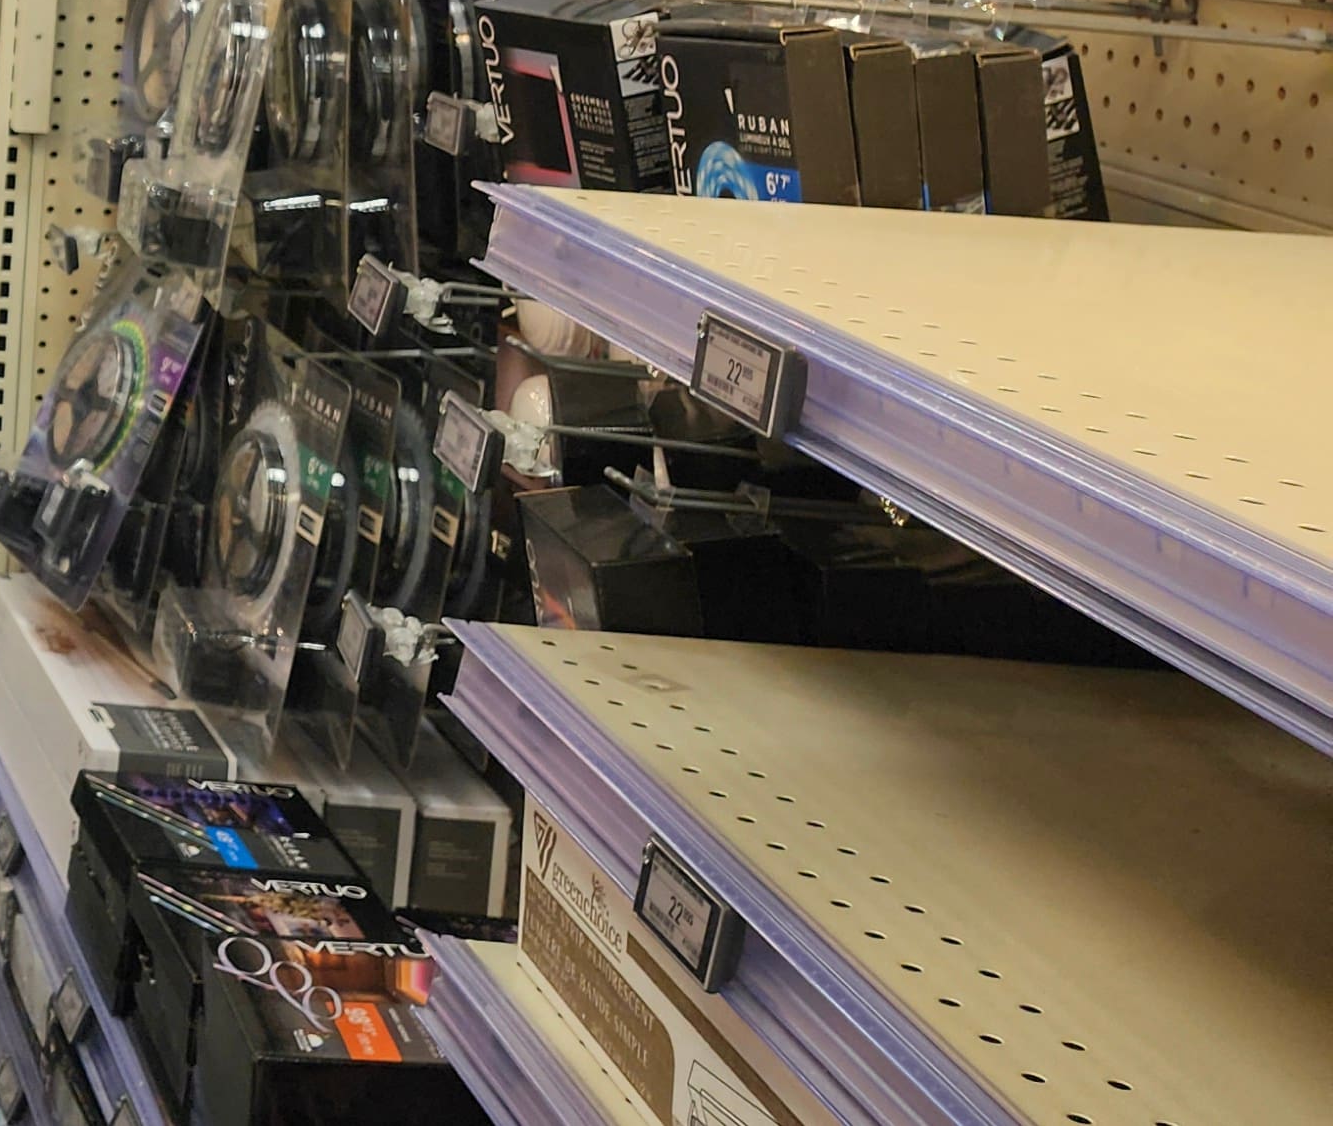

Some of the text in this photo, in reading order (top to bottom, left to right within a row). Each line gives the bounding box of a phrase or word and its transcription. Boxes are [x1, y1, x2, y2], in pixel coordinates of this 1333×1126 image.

[478, 15, 515, 146] VERTUO
[660, 54, 693, 196] ERTUO
[738, 114, 791, 137] RUBAN
[188, 778, 295, 799] VERTUO
[250, 877, 368, 900] VERTUO
[552, 861, 623, 954] greenchoice
[294, 939, 431, 960] VERTU
